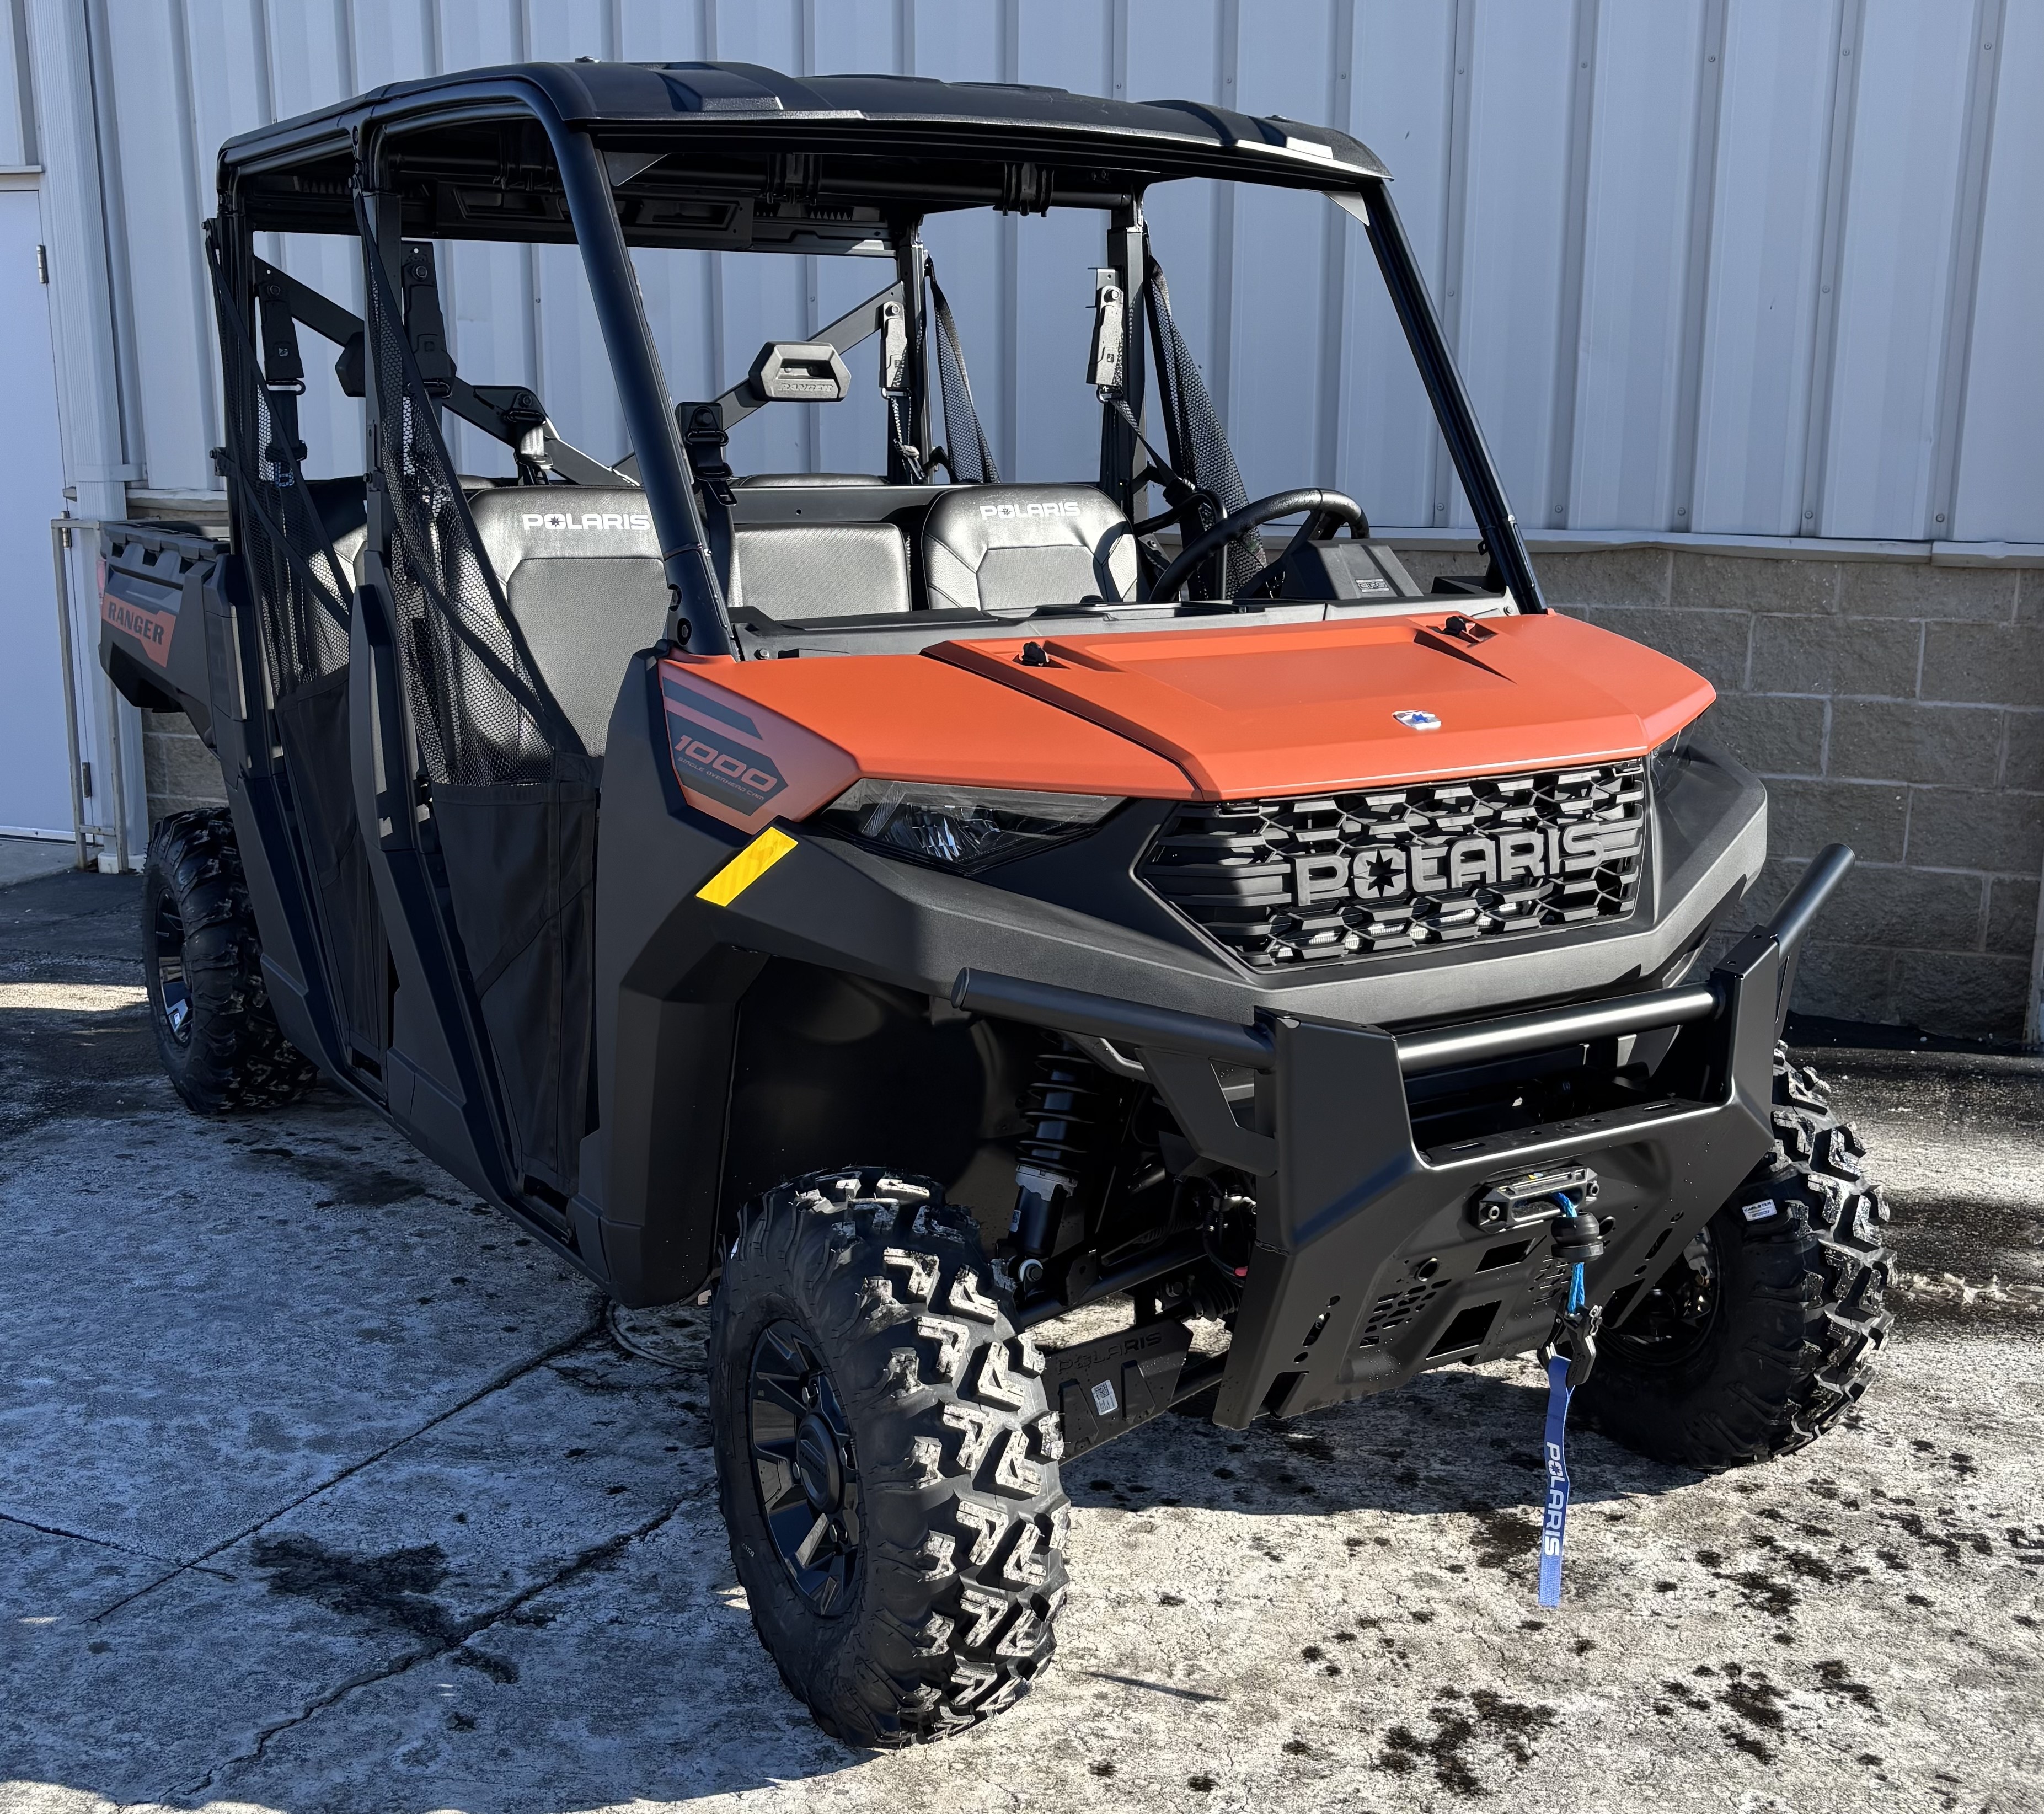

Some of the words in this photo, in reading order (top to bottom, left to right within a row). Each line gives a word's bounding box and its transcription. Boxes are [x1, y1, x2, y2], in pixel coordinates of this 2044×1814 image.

[778, 383, 834, 392] RANGER
[522, 513, 651, 531] POLARIS
[980, 502, 1080, 520] POLARIS
[108, 601, 164, 645] RANGER
[675, 735, 777, 793] 1000
[746, 789, 764, 801] CAM
[1293, 822, 1604, 906] POLARIS
[1057, 1332, 1162, 1374] POLARIS
[1544, 1441, 1565, 1556] POLARIS
